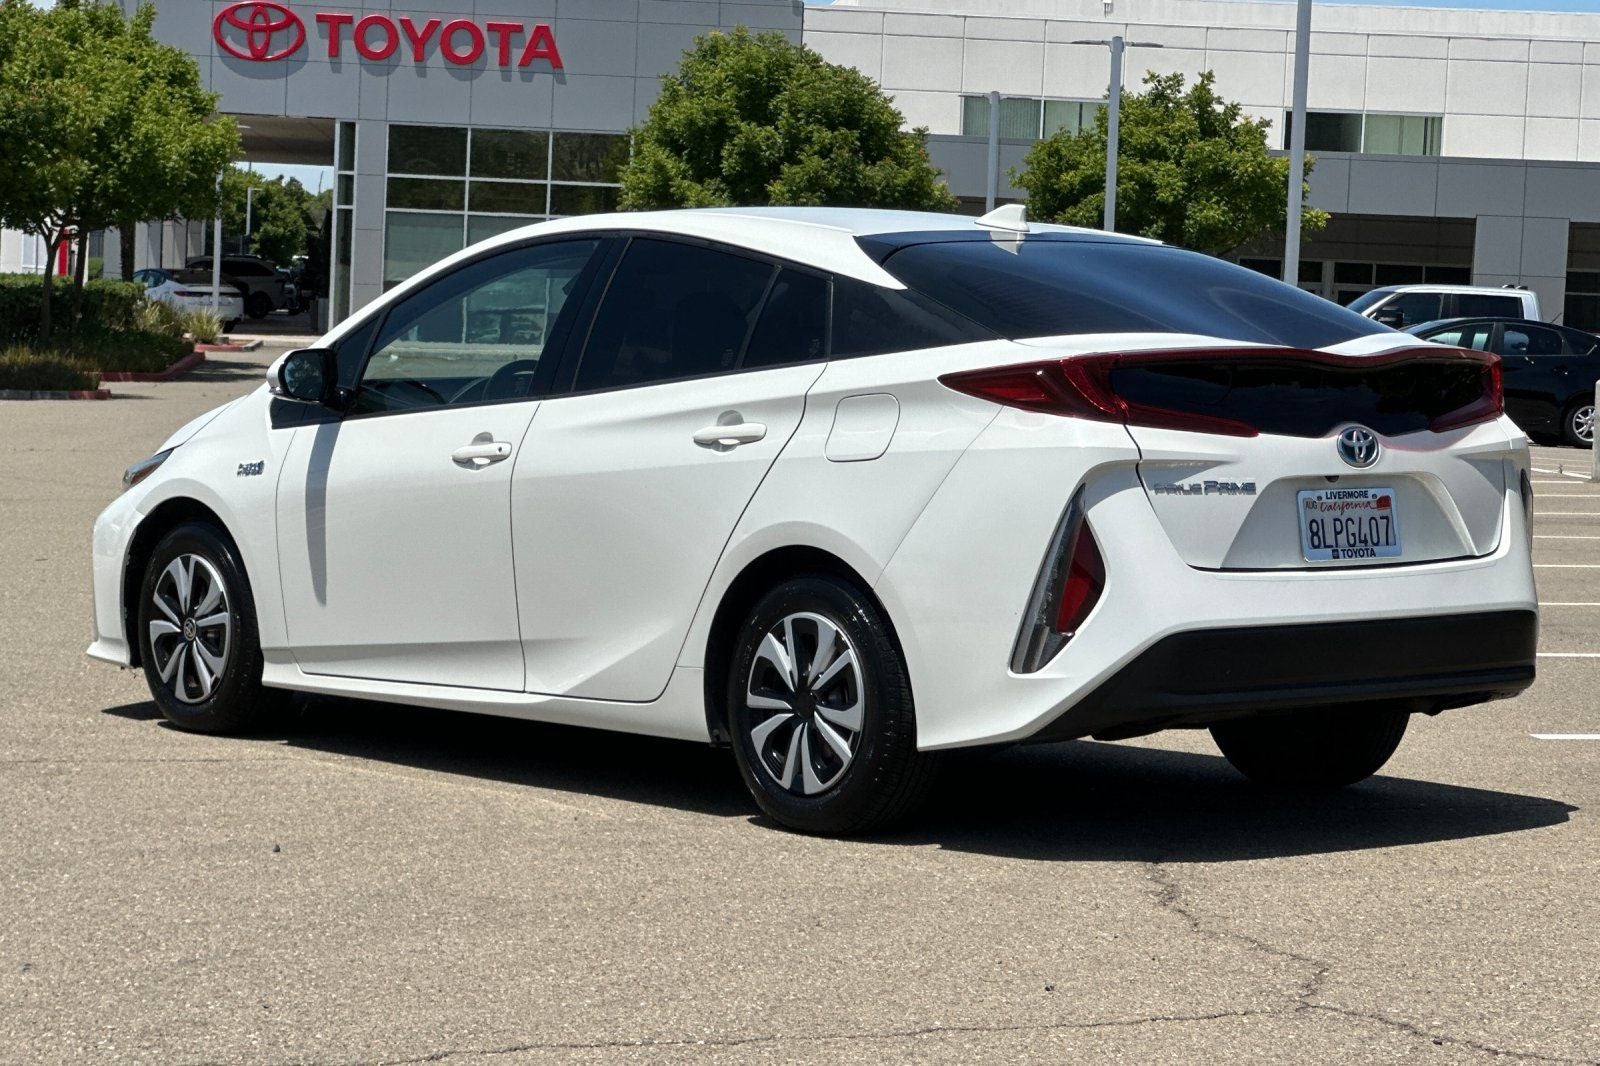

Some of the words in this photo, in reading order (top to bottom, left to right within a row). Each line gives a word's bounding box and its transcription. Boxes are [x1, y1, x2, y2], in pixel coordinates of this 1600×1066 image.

[316, 13, 563, 69] TOYOTA
[1204, 481, 1256, 495] PRIME
[1325, 490, 1369, 500] LIVERMORE
[1320, 500, 1373, 515] California
[1309, 515, 1390, 549] 8LPG407
[1341, 547, 1376, 559] TOYOTA
